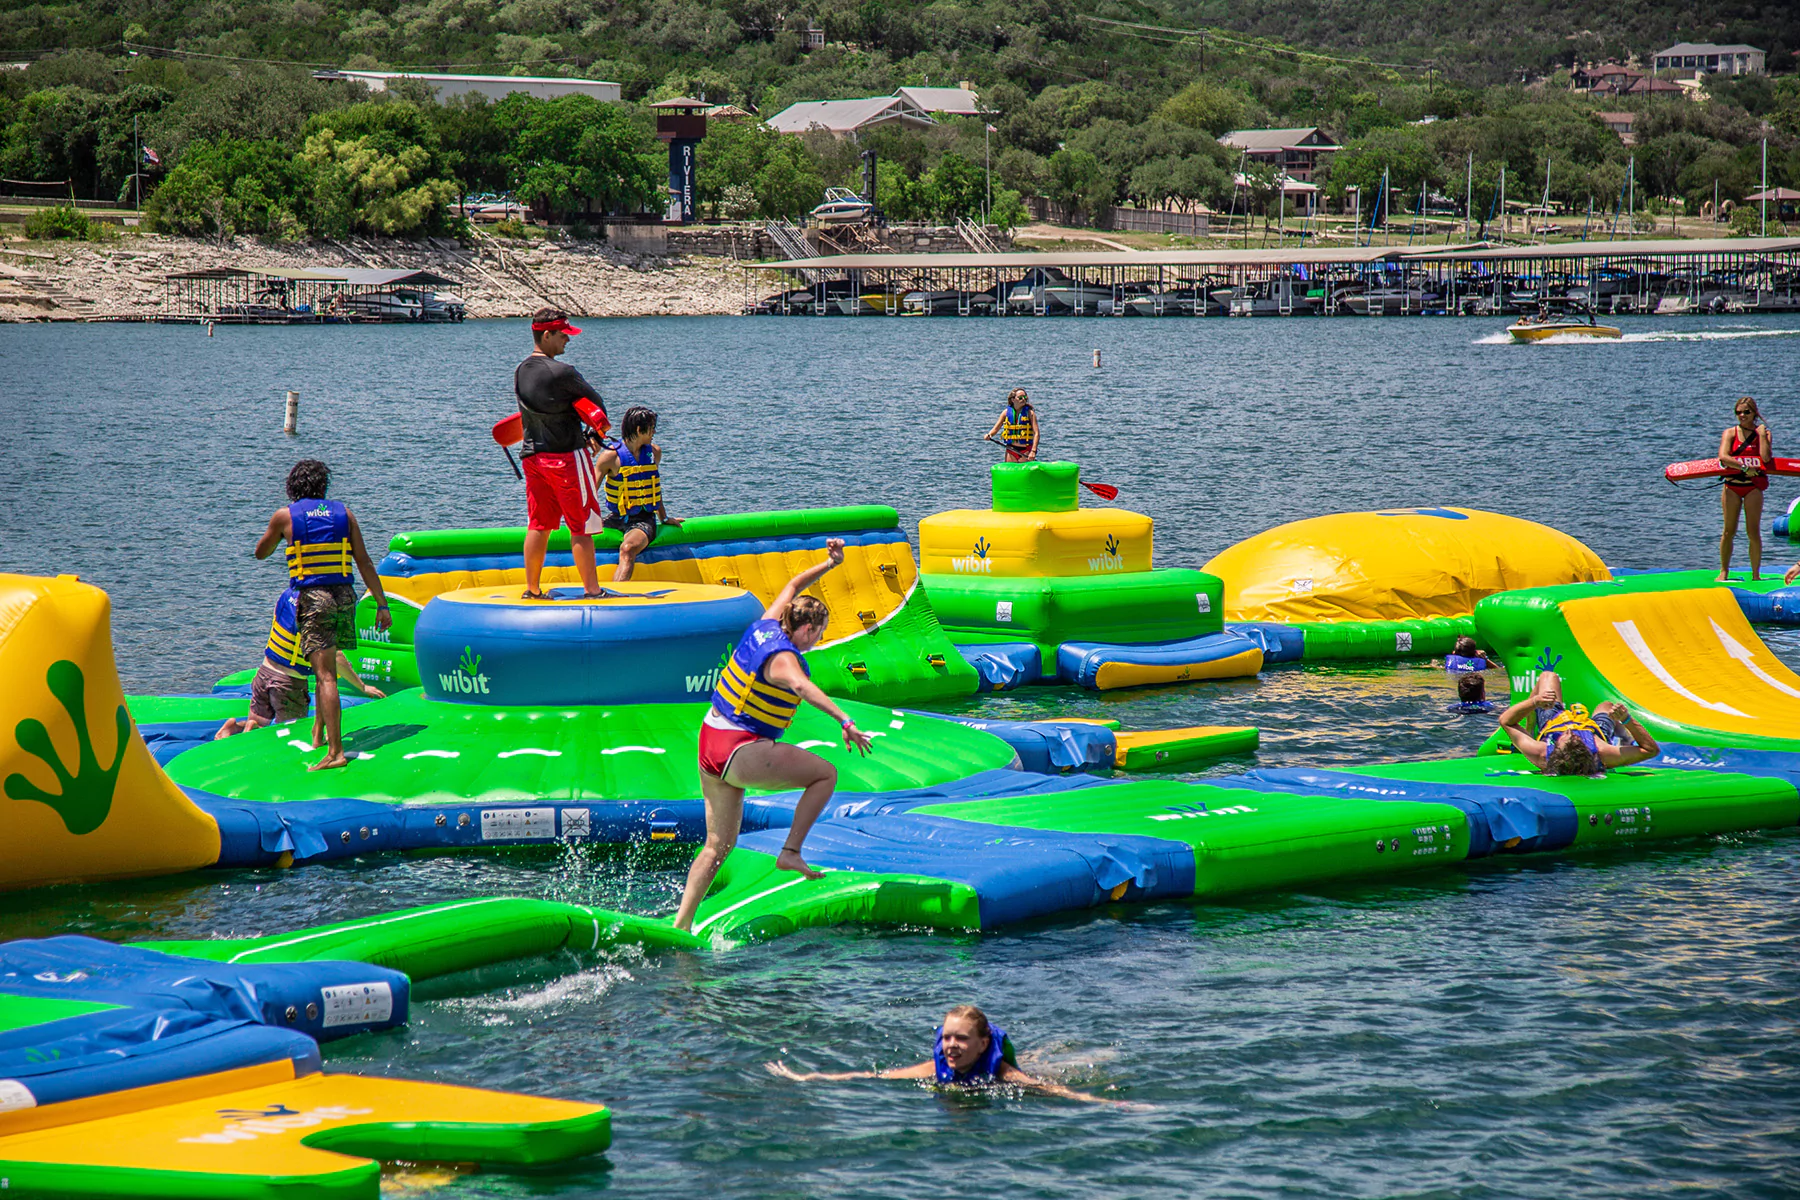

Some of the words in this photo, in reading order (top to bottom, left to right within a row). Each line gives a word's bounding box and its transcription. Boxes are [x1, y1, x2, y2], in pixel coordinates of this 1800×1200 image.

[683, 145, 692, 216] RIVIERA
[306, 508, 330, 517] wibit
[952, 554, 993, 573] wibit
[1088, 553, 1124, 571] wibit
[359, 625, 391, 643] wibit
[438, 669, 491, 694] wibit
